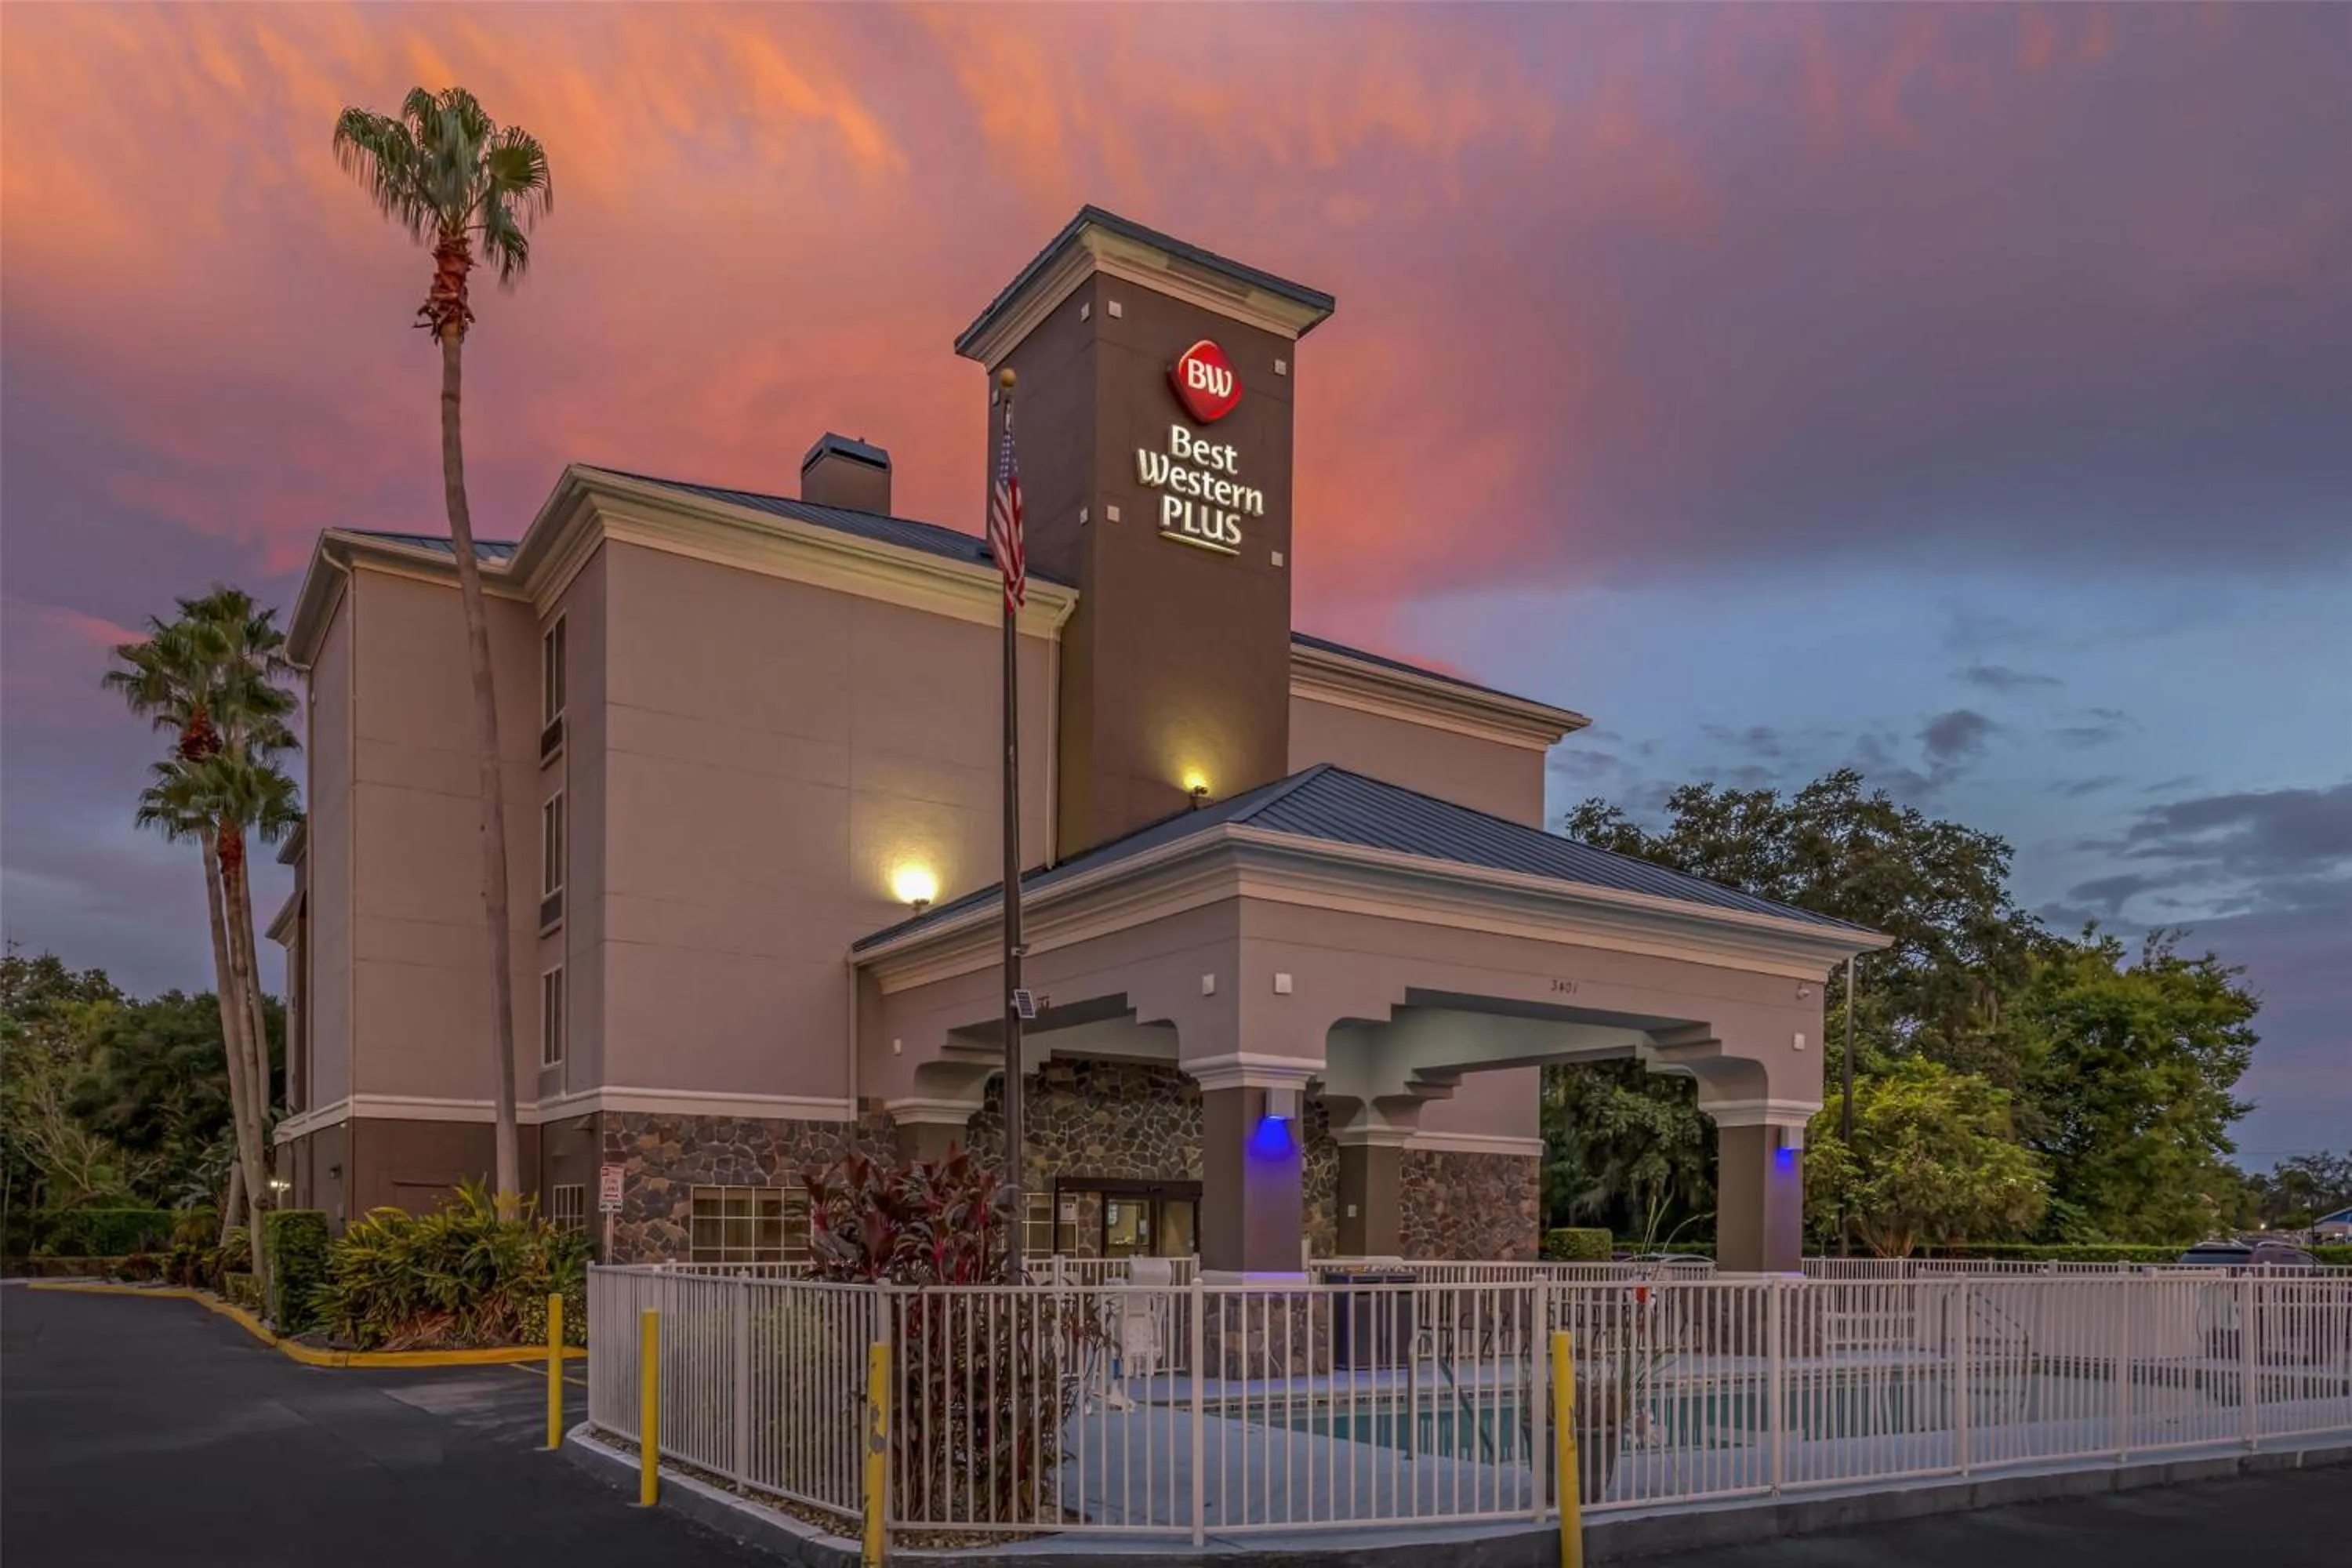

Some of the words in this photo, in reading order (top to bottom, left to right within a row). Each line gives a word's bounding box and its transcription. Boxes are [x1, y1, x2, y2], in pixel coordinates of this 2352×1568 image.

[1187, 358, 1232, 397] BW
[1171, 424, 1238, 475] Best
[1138, 448, 1264, 517] Western
[1160, 495, 1242, 545] PLUS
